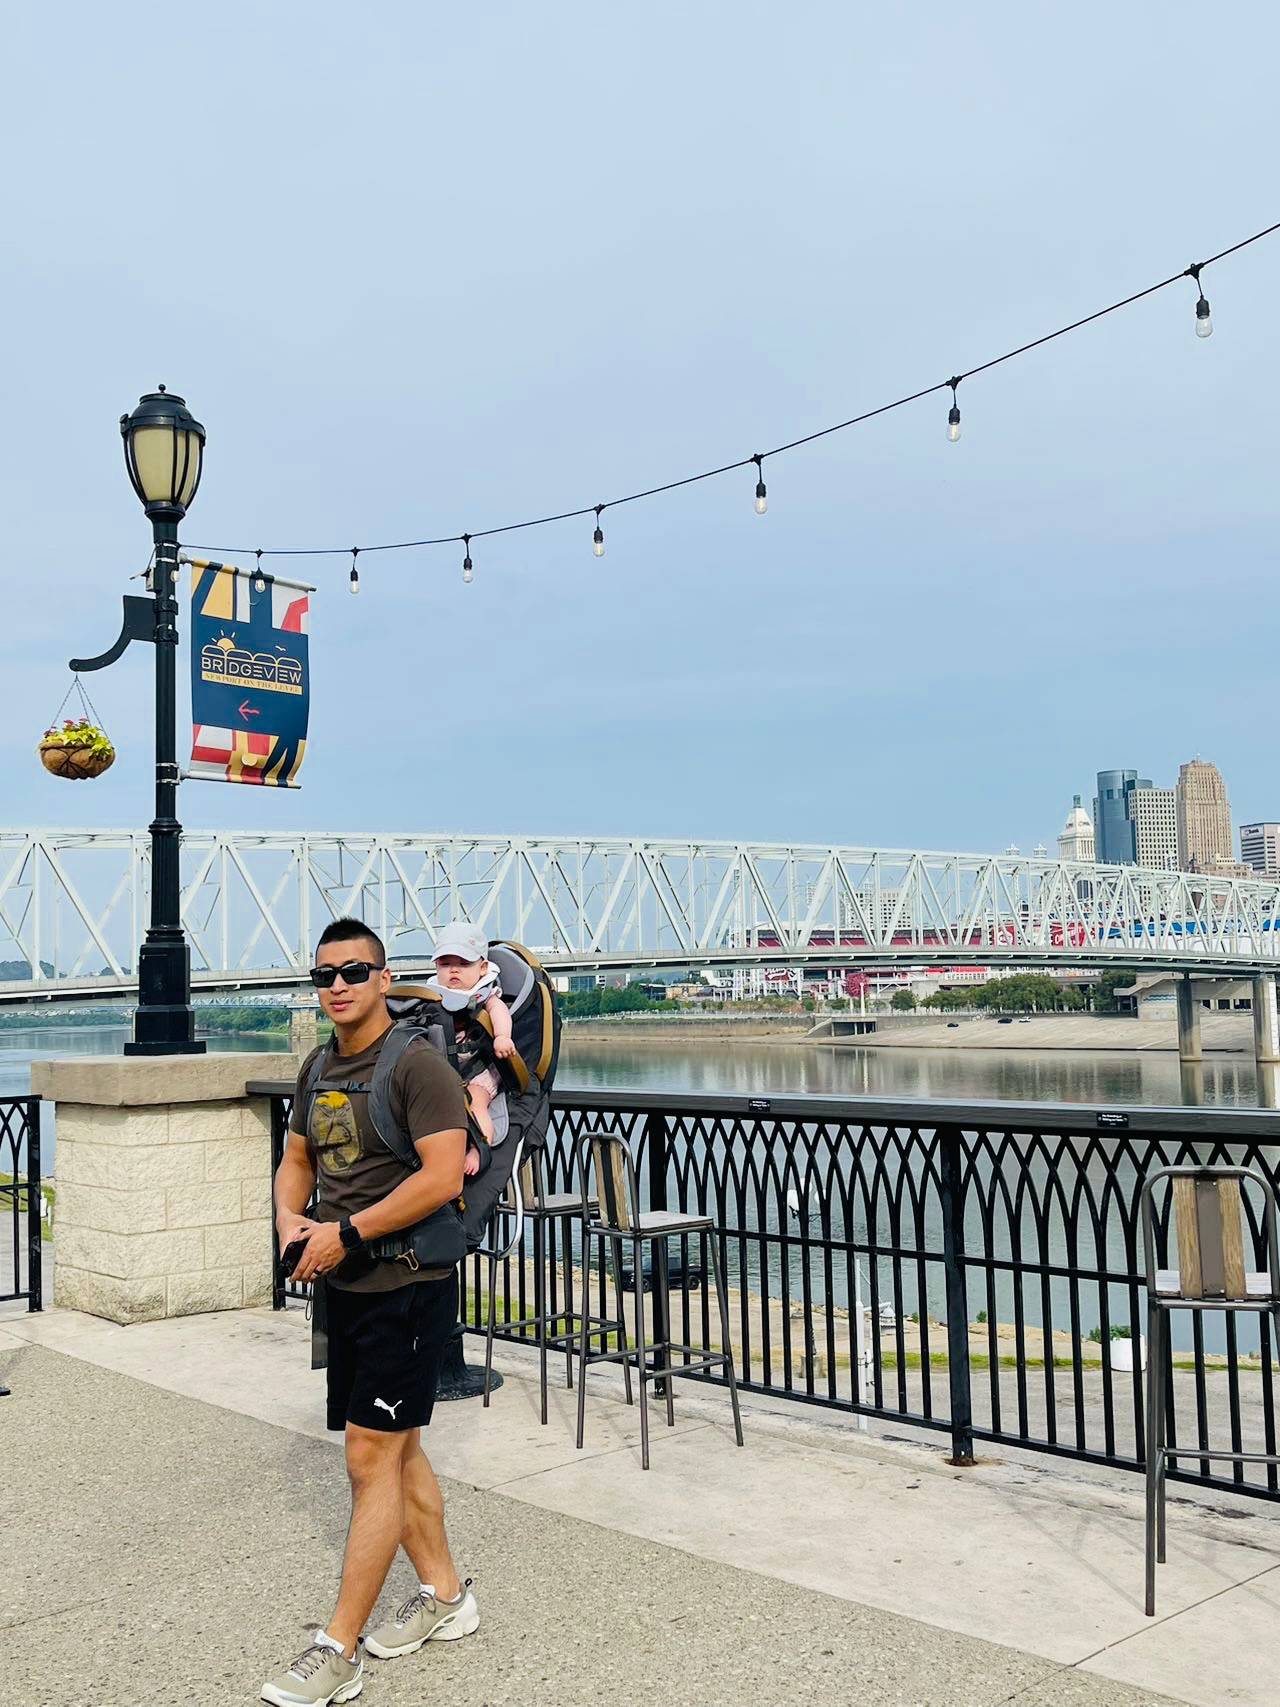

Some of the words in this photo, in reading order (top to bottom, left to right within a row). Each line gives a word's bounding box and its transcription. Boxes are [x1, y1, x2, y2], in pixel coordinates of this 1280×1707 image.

[201, 657, 302, 684] BRIDGEVIEW
[205, 672, 241, 685] NEWPORT
[243, 678, 254, 687] ON
[257, 680, 273, 689] THE
